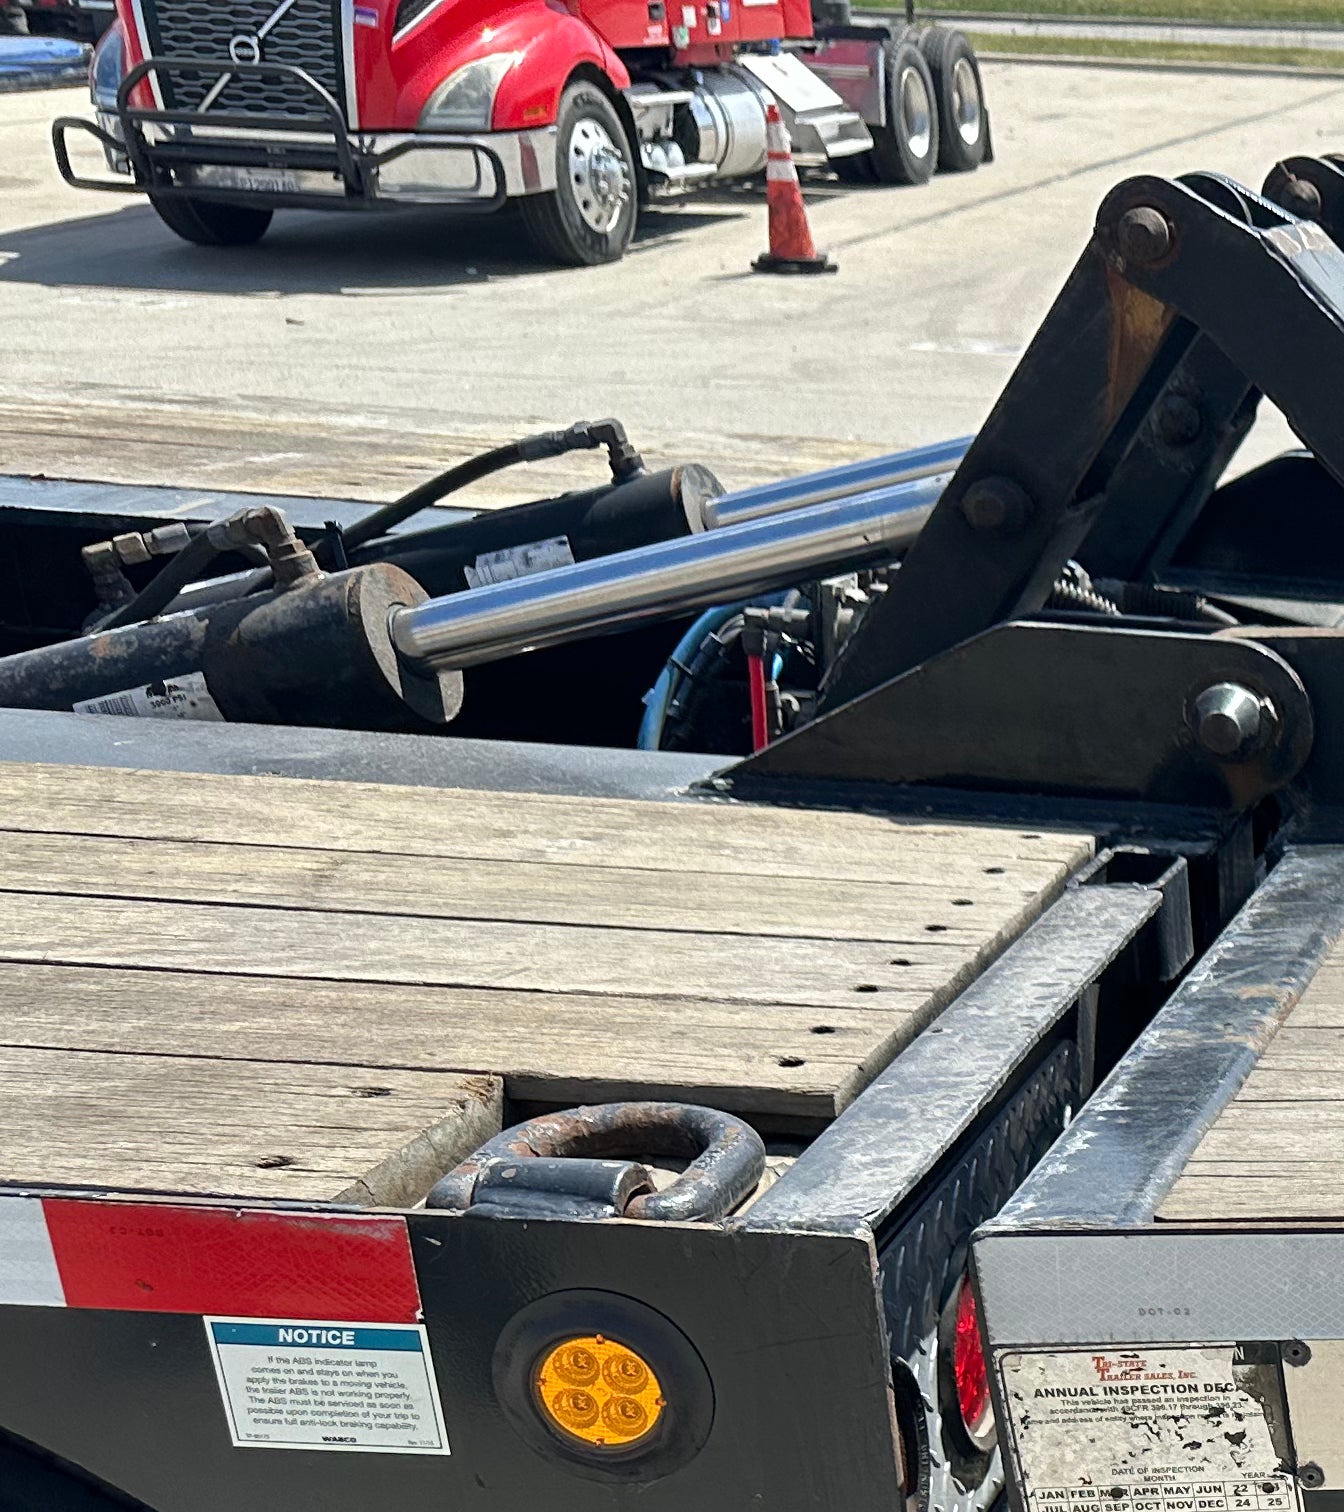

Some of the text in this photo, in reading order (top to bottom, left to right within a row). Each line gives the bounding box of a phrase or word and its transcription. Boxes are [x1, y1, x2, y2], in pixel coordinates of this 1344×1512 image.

[278, 1327, 356, 1346] NOTICE
[276, 1356, 290, 1365] the
[293, 1357, 312, 1365] ABS
[315, 1358, 352, 1367] indicator
[355, 1359, 377, 1369] lamp
[251, 1367, 281, 1375] comes
[297, 1367, 314, 1376] and
[316, 1368, 340, 1377] stays
[356, 1370, 380, 1379] when
[381, 1371, 398, 1380] you
[246, 1376, 270, 1385] apply
[272, 1376, 287, 1384] the
[289, 1377, 318, 1386] brakes
[321, 1378, 331, 1386] to
[340, 1380, 372, 1389] moving
[246, 1385, 260, 1394] the
[289, 1387, 309, 1395] ABS
[321, 1388, 335, 1397] not
[338, 1389, 372, 1399] working
[1034, 1386, 1100, 1398] ANNUAL
[1103, 1383, 1199, 1396] INSPECTION
[249, 1396, 265, 1404] The
[268, 1397, 287, 1405] ABS
[290, 1398, 312, 1406] must
[314, 1398, 325, 1407] be
[328, 1399, 364, 1408] serviced
[1081, 1398, 1112, 1406] vehicle
[1113, 1397, 1128, 1405] has
[1131, 1396, 1162, 1406] passed
[1177, 1395, 1221, 1404] inspection
[286, 1408, 309, 1418] upon
[310, 1409, 359, 1419] completion
[362, 1411, 371, 1419] of
[372, 1412, 392, 1421] your
[394, 1412, 408, 1421] trip
[411, 1413, 420, 1421] to
[300, 1419, 338, 1428] anti-lock
[340, 1420, 372, 1430] braking
[321, 1435, 357, 1443] WABCO
[1111, 1466, 1135, 1476] DATE
[1151, 1465, 1205, 1475] INSPECTION
[1241, 1471, 1266, 1479] YEAR
[1039, 1490, 1065, 1500] JAN
[1070, 1489, 1096, 1498] FEB
[1100, 1488, 1129, 1498] MR
[1133, 1487, 1160, 1496] APR
[1163, 1486, 1191, 1495] MAY
[1195, 1485, 1222, 1494] JUN
[1072, 1504, 1100, 1512] AUG
[1104, 1503, 1130, 1512] SEP
[1135, 1501, 1161, 1511] OCT
[1166, 1500, 1193, 1510] NOV
[1198, 1499, 1225, 1509] DEC
[1235, 1498, 1251, 1507] 24
[1267, 1497, 1283, 1507] 25
